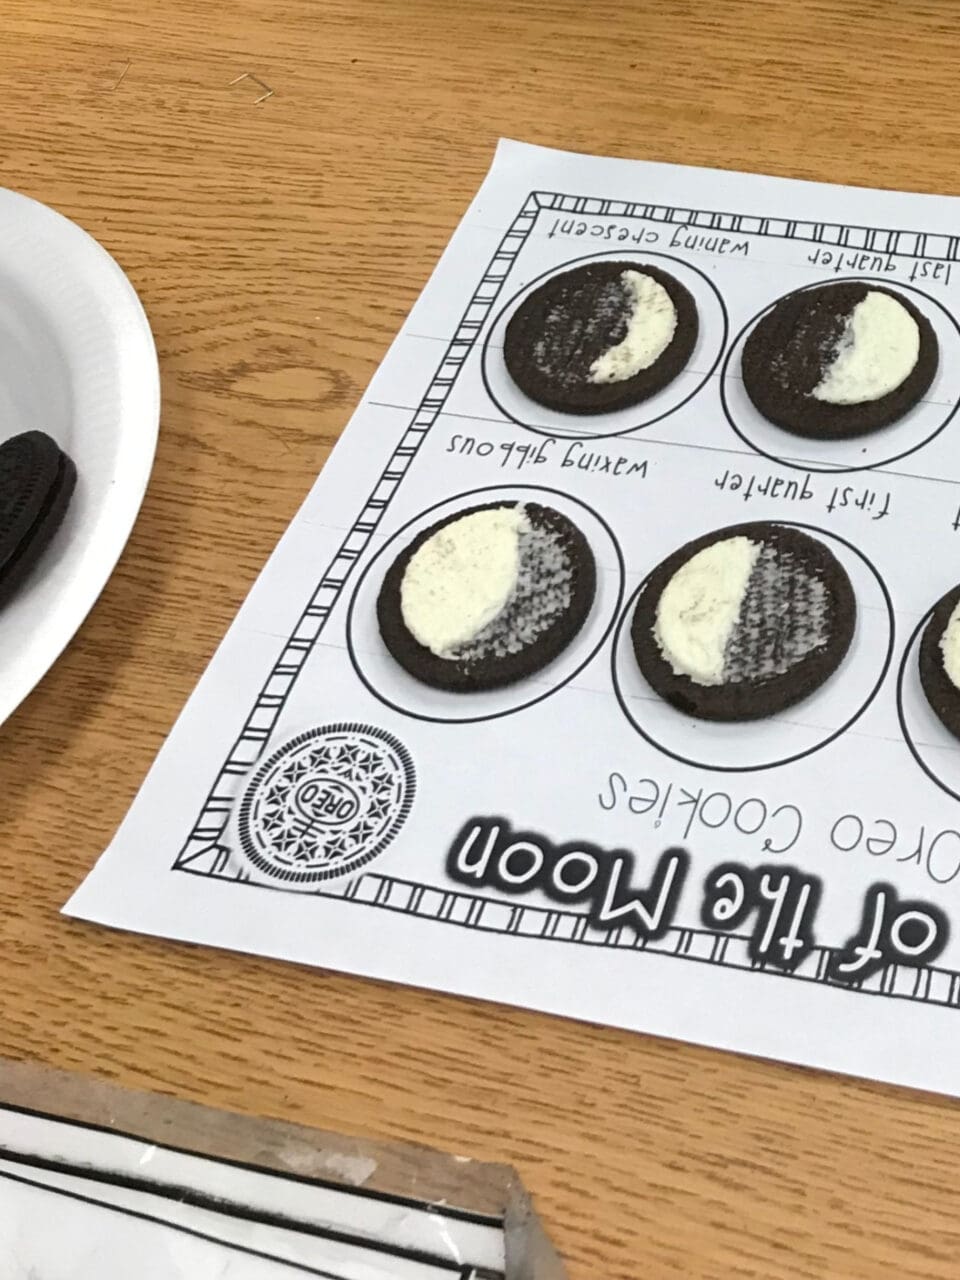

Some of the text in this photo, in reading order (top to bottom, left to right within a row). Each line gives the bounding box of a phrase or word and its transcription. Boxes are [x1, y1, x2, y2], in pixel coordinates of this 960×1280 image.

[548, 218, 750, 256] waning crescent
[807, 247, 952, 286] last quarter
[445, 432, 649, 480] waxing gibbous
[714, 469, 893, 521] first quarter
[300, 783, 356, 820] OREO
[598, 771, 803, 854] Cookies
[456, 824, 681, 931] Moon
[711, 870, 813, 961] the
[836, 890, 939, 973] of
